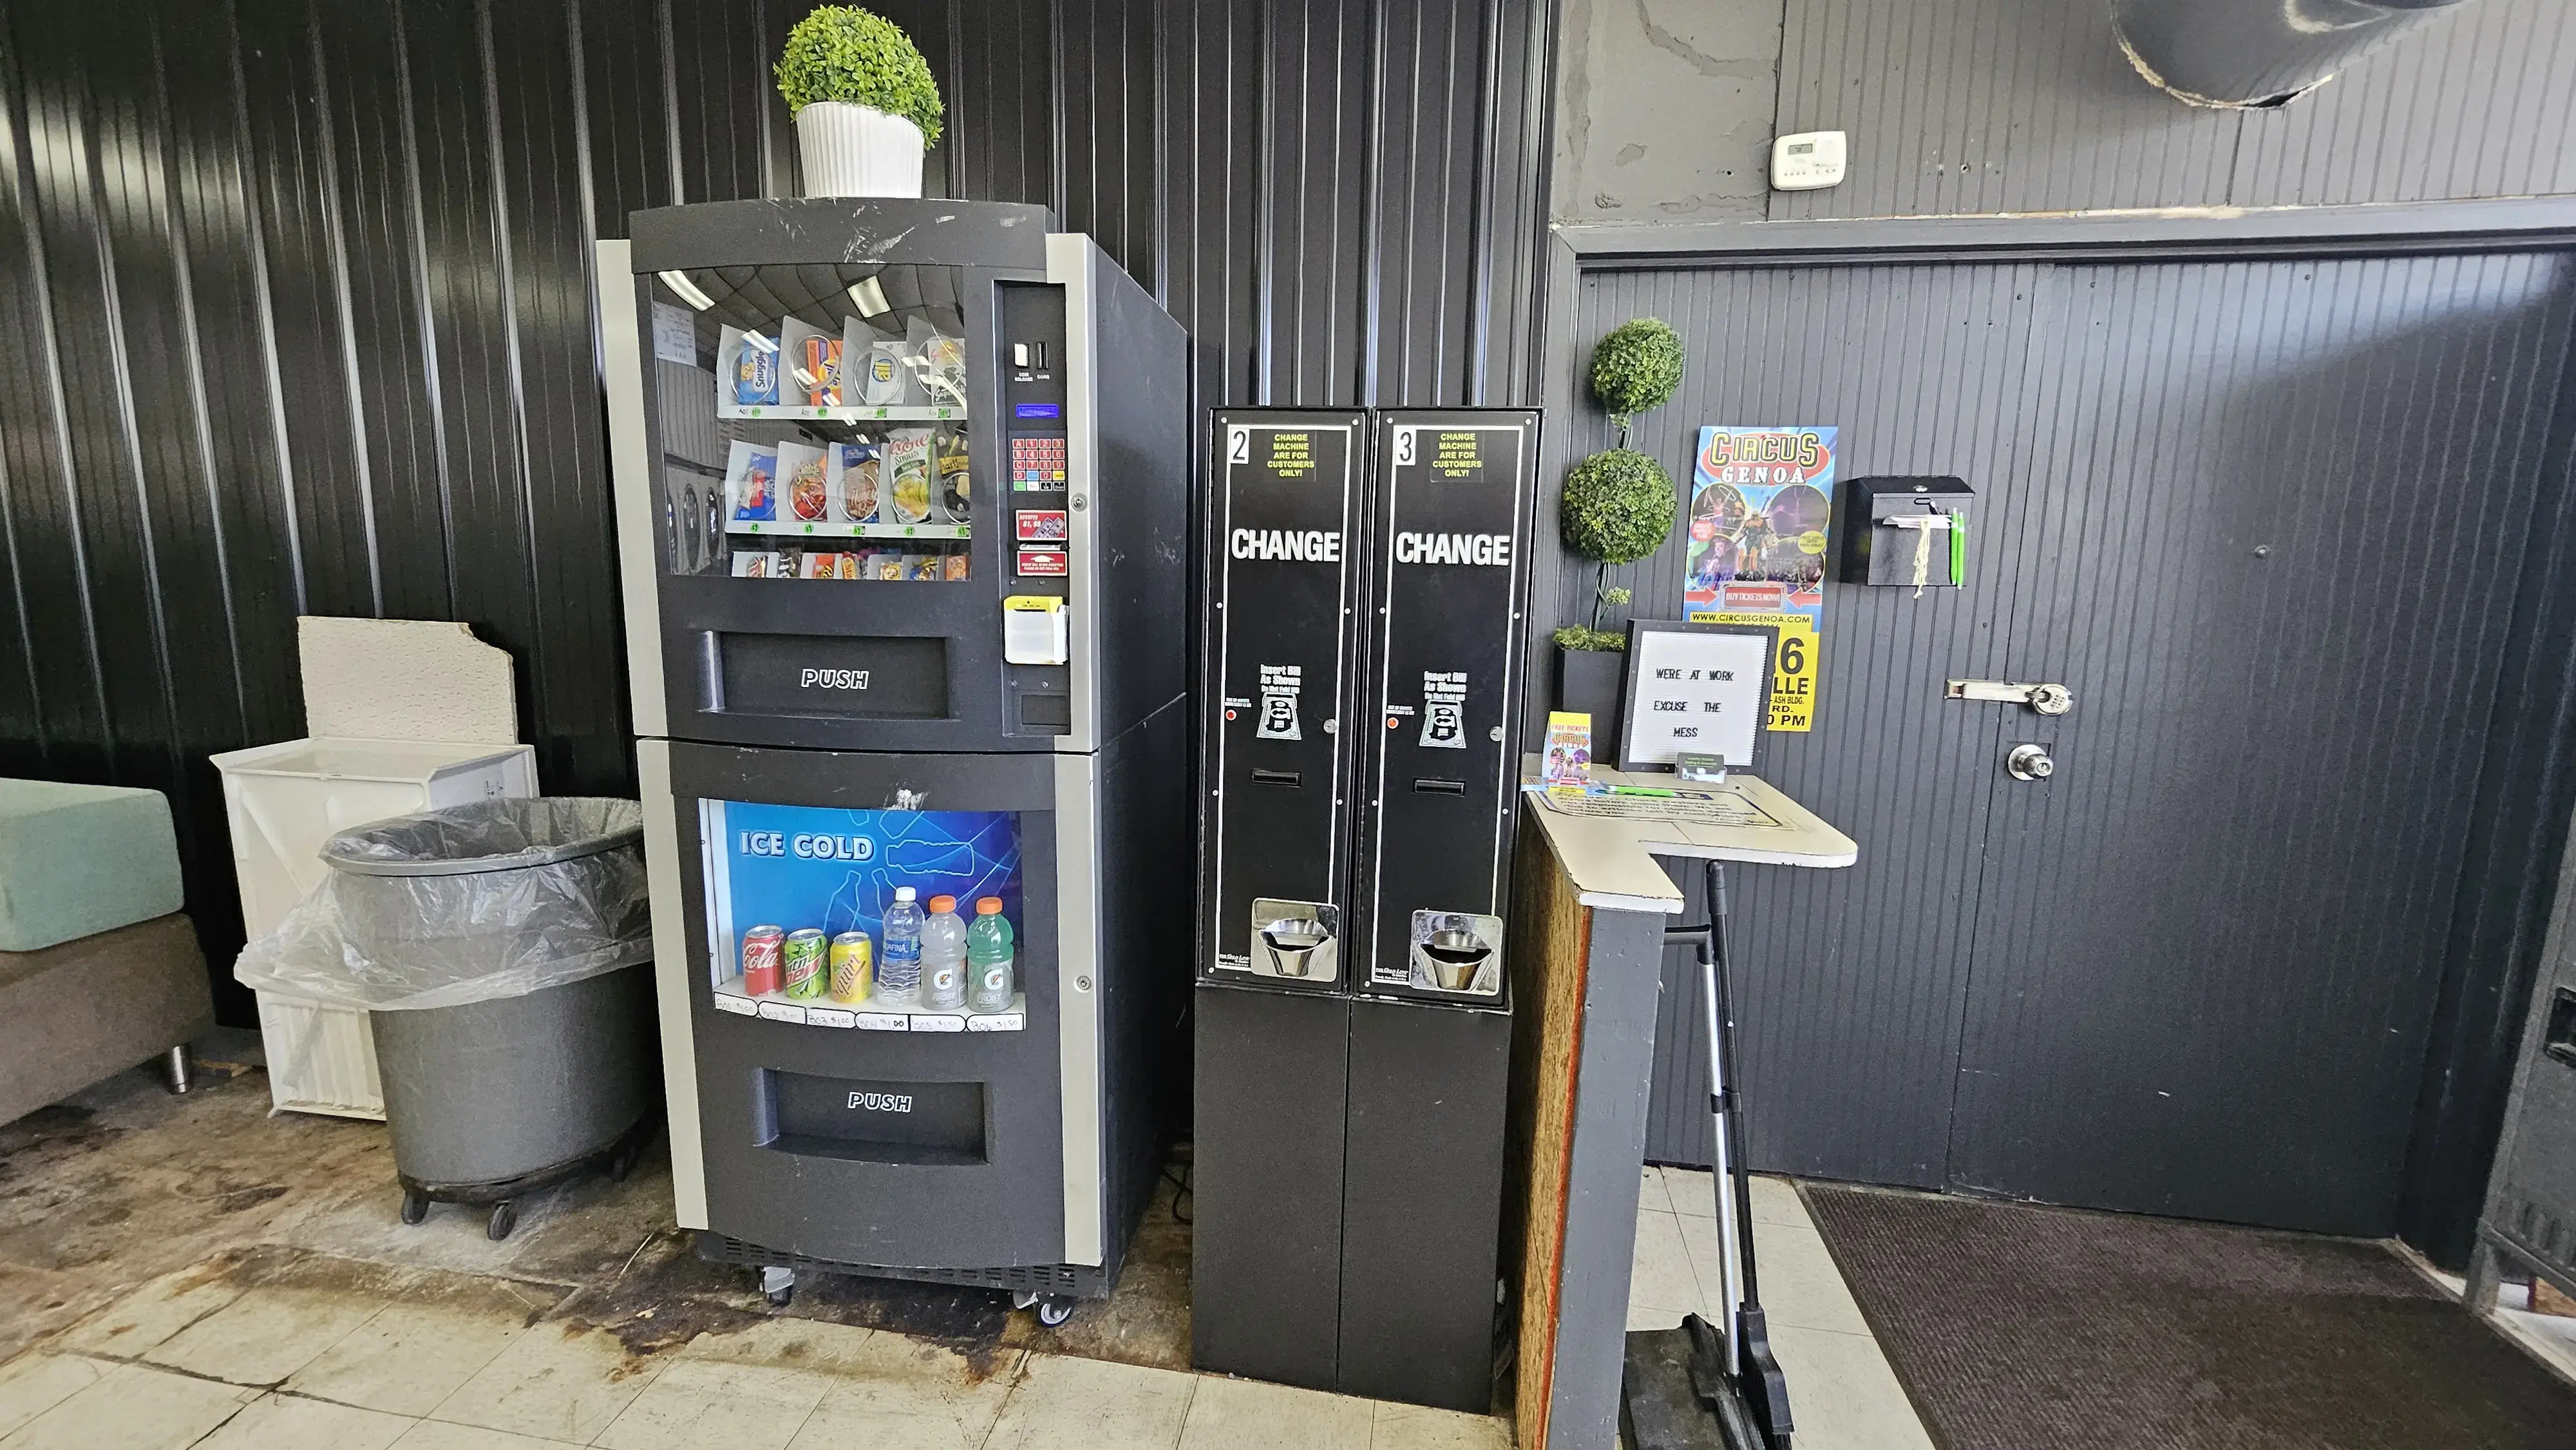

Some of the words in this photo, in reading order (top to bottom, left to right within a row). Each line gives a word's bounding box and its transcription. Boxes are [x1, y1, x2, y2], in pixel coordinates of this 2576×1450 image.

[755, 350, 766, 388] Snuggle
[1233, 431, 1247, 460] 2
[1399, 432, 1412, 462] 3
[1710, 432, 1819, 467] CIRCUS
[1721, 466, 1806, 484] GENOA
[1231, 529, 1340, 561] CHANGE
[1396, 532, 1510, 566] CHANGE
[1726, 592, 1738, 601] BUY
[1739, 592, 1763, 601] TICKETS
[1763, 594, 1780, 602] NOW!
[1692, 613, 1810, 623] WWW.CIRCUSGENOA.COM
[1774, 637, 1804, 675] 6
[801, 668, 869, 690] PUSH
[1260, 664, 1287, 675] Insert
[1287, 665, 1301, 676] Bill
[1424, 671, 1452, 682] Insert
[1452, 672, 1467, 683] Bill
[1656, 668, 1681, 679] WERE
[1689, 670, 1701, 680] AT
[1709, 670, 1734, 681] WORK
[1260, 674, 1271, 684] As
[1273, 675, 1301, 686] Shown
[1424, 681, 1435, 692] As
[1436, 681, 1466, 693] Shown
[1653, 701, 1688, 711] EXCUSE
[1703, 702, 1721, 712] THE
[1788, 696, 1804, 704] BLDG.
[1781, 715, 1805, 726] PM
[1673, 727, 1698, 737] MESS
[741, 831, 785, 857] ICE
[793, 834, 875, 862] COLD
[934, 968, 953, 990] G
[985, 968, 1004, 990] G
[848, 1092, 913, 1113] PUSH
